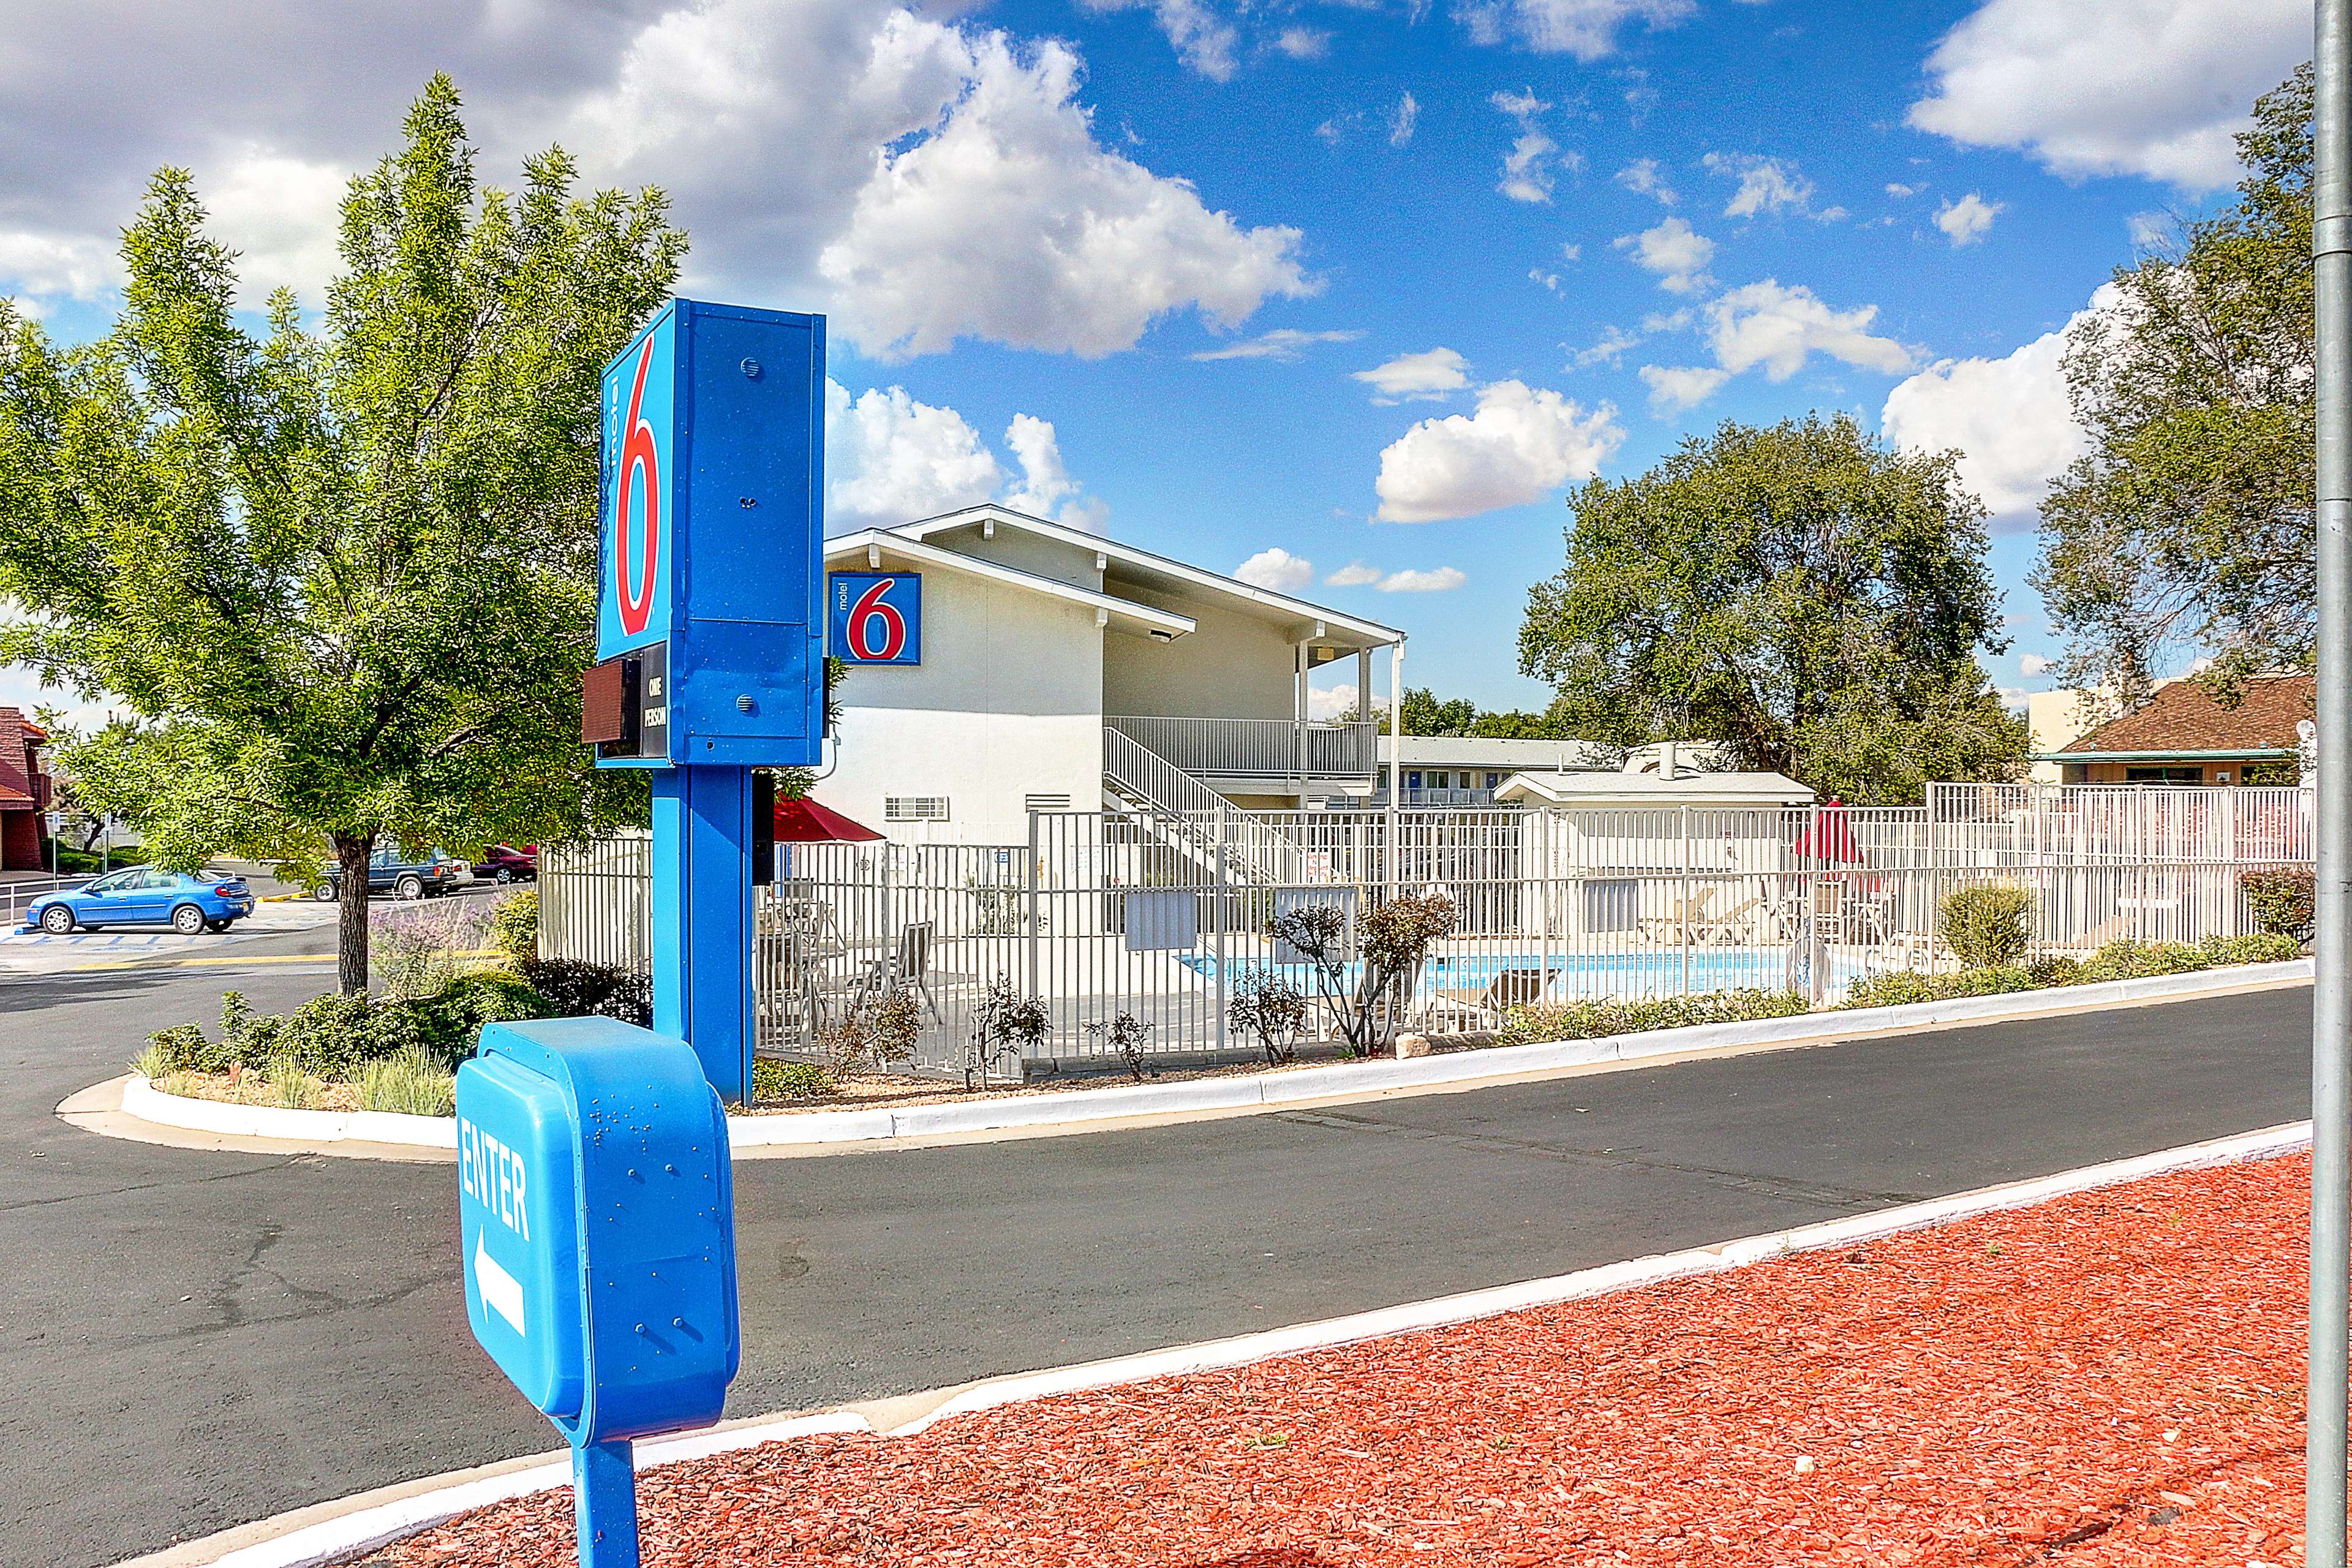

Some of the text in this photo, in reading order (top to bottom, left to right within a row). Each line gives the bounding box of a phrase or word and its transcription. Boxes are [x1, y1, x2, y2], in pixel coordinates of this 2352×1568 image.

[614, 331, 660, 637] 6
[838, 578, 907, 660] motel 6
[644, 706, 666, 727] PERSON
[649, 676, 662, 697] ONE
[461, 1116, 530, 1242] ENTER
